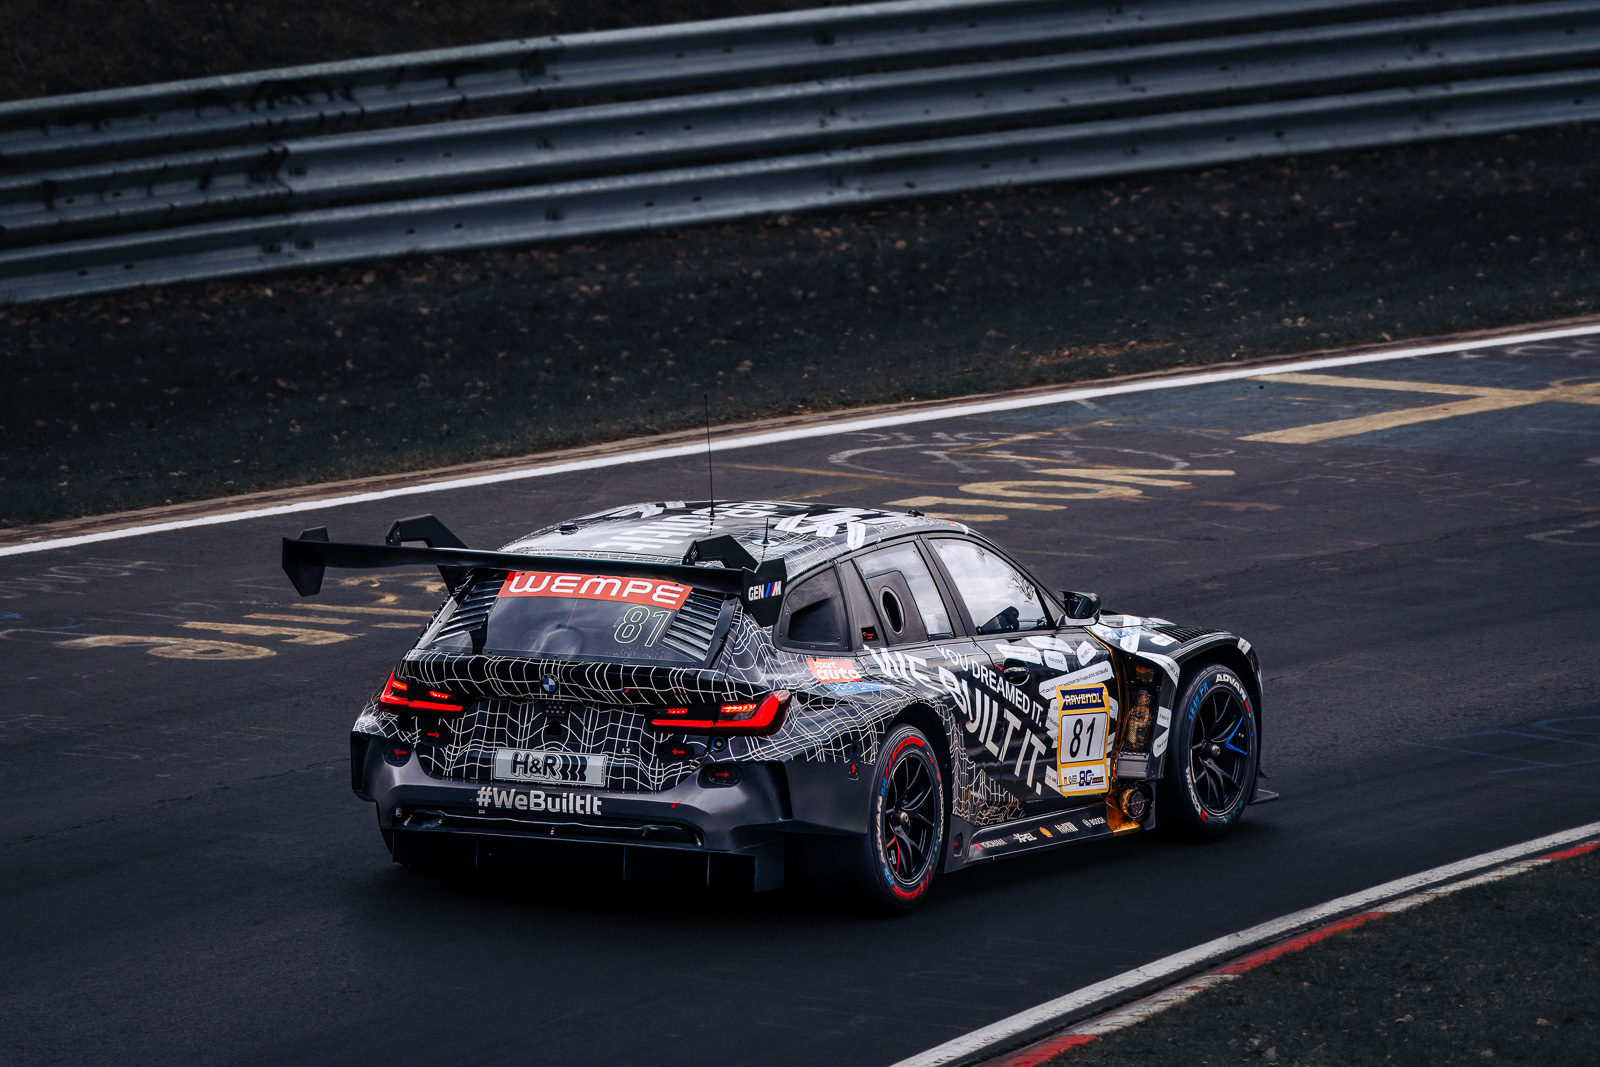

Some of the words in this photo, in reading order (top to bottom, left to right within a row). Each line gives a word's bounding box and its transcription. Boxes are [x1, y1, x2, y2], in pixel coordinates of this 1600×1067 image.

[508, 575, 686, 605] WEMPE
[748, 584, 764, 601] GEN
[613, 605, 671, 647] 81
[814, 661, 837, 669] sport
[816, 667, 861, 680] auto
[863, 644, 946, 696] WE
[934, 643, 969, 672] YOU
[971, 659, 1031, 715] DREAMED
[1030, 700, 1045, 728] IT.
[1064, 692, 1103, 706] RAVENOL
[1215, 673, 1247, 701] ADVAN
[937, 665, 1022, 763] BUILT
[1014, 728, 1047, 796] IT.
[1069, 717, 1096, 759] 81
[511, 753, 560, 781] H&R
[476, 786, 602, 815] #WeBuiltIt
